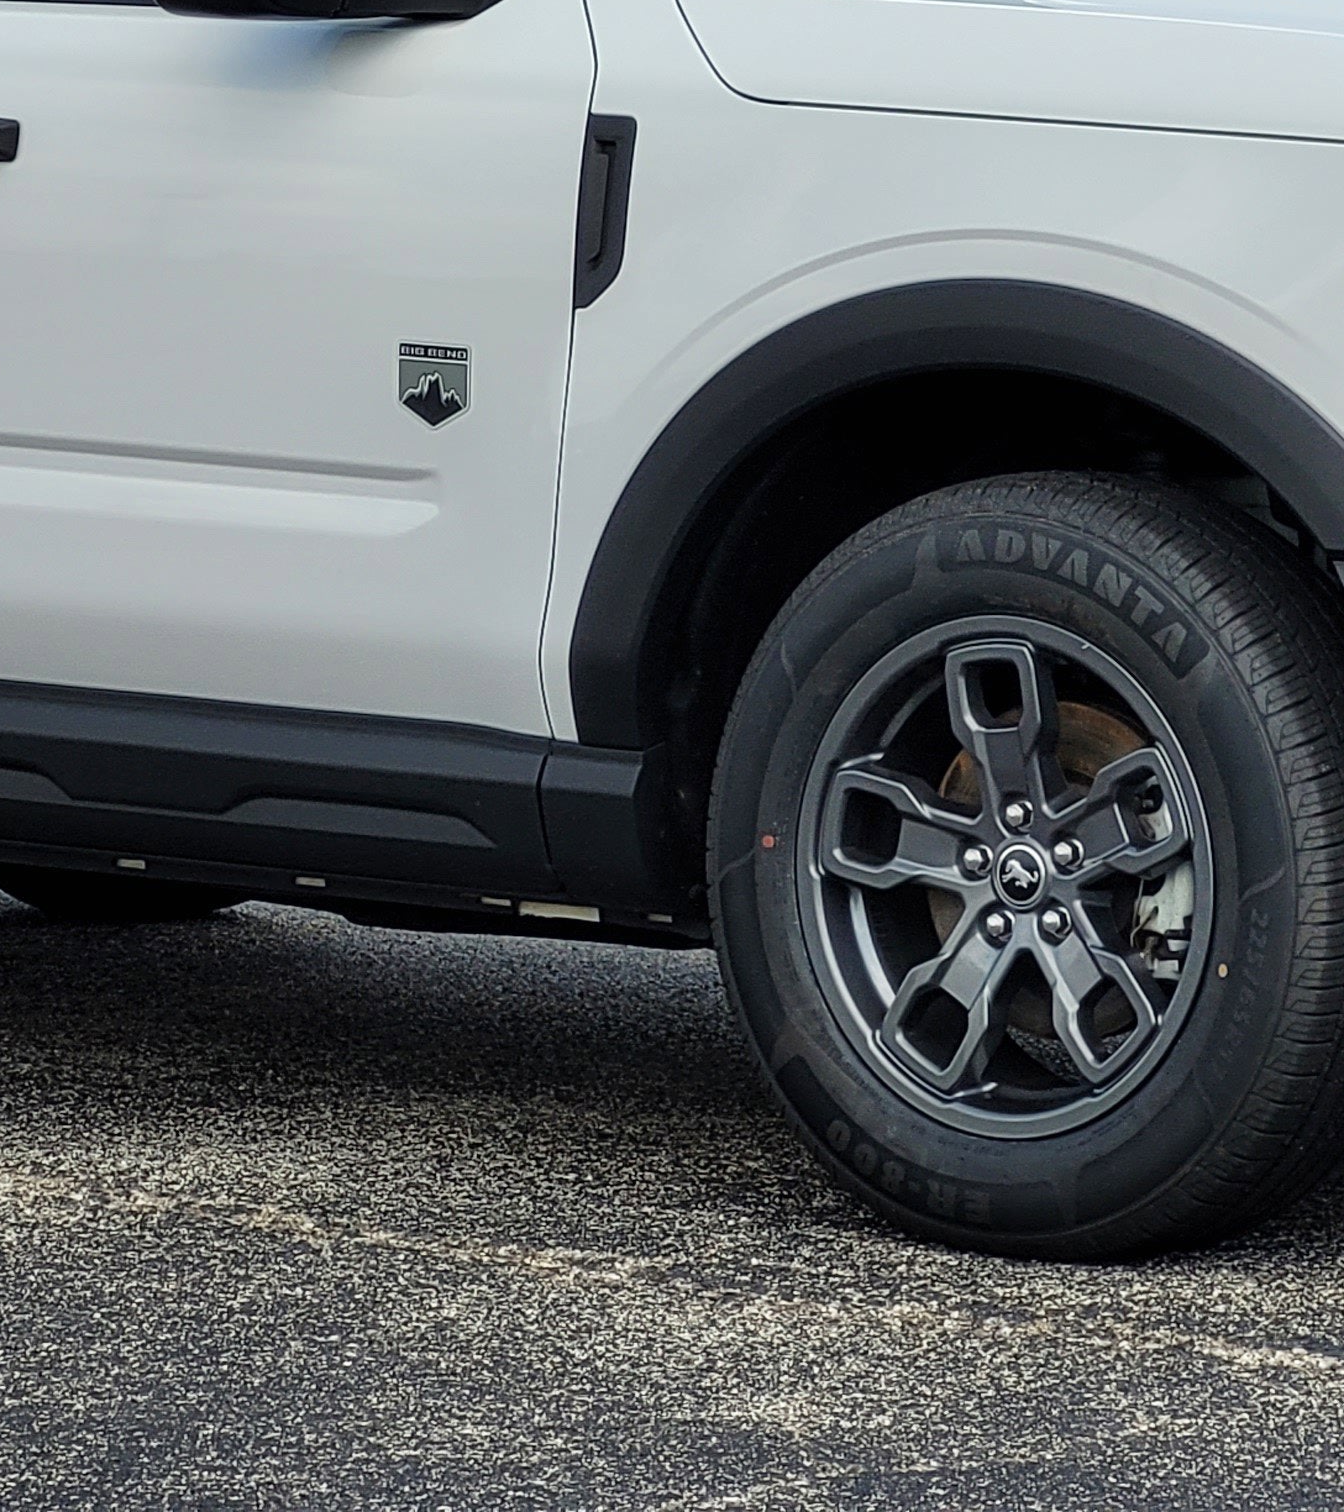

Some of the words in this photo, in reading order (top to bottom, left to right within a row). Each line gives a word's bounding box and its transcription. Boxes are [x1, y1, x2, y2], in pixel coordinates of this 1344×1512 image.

[401, 345, 425, 356] BIG
[428, 348, 467, 359] BEND
[956, 528, 1188, 663] ADVANTA
